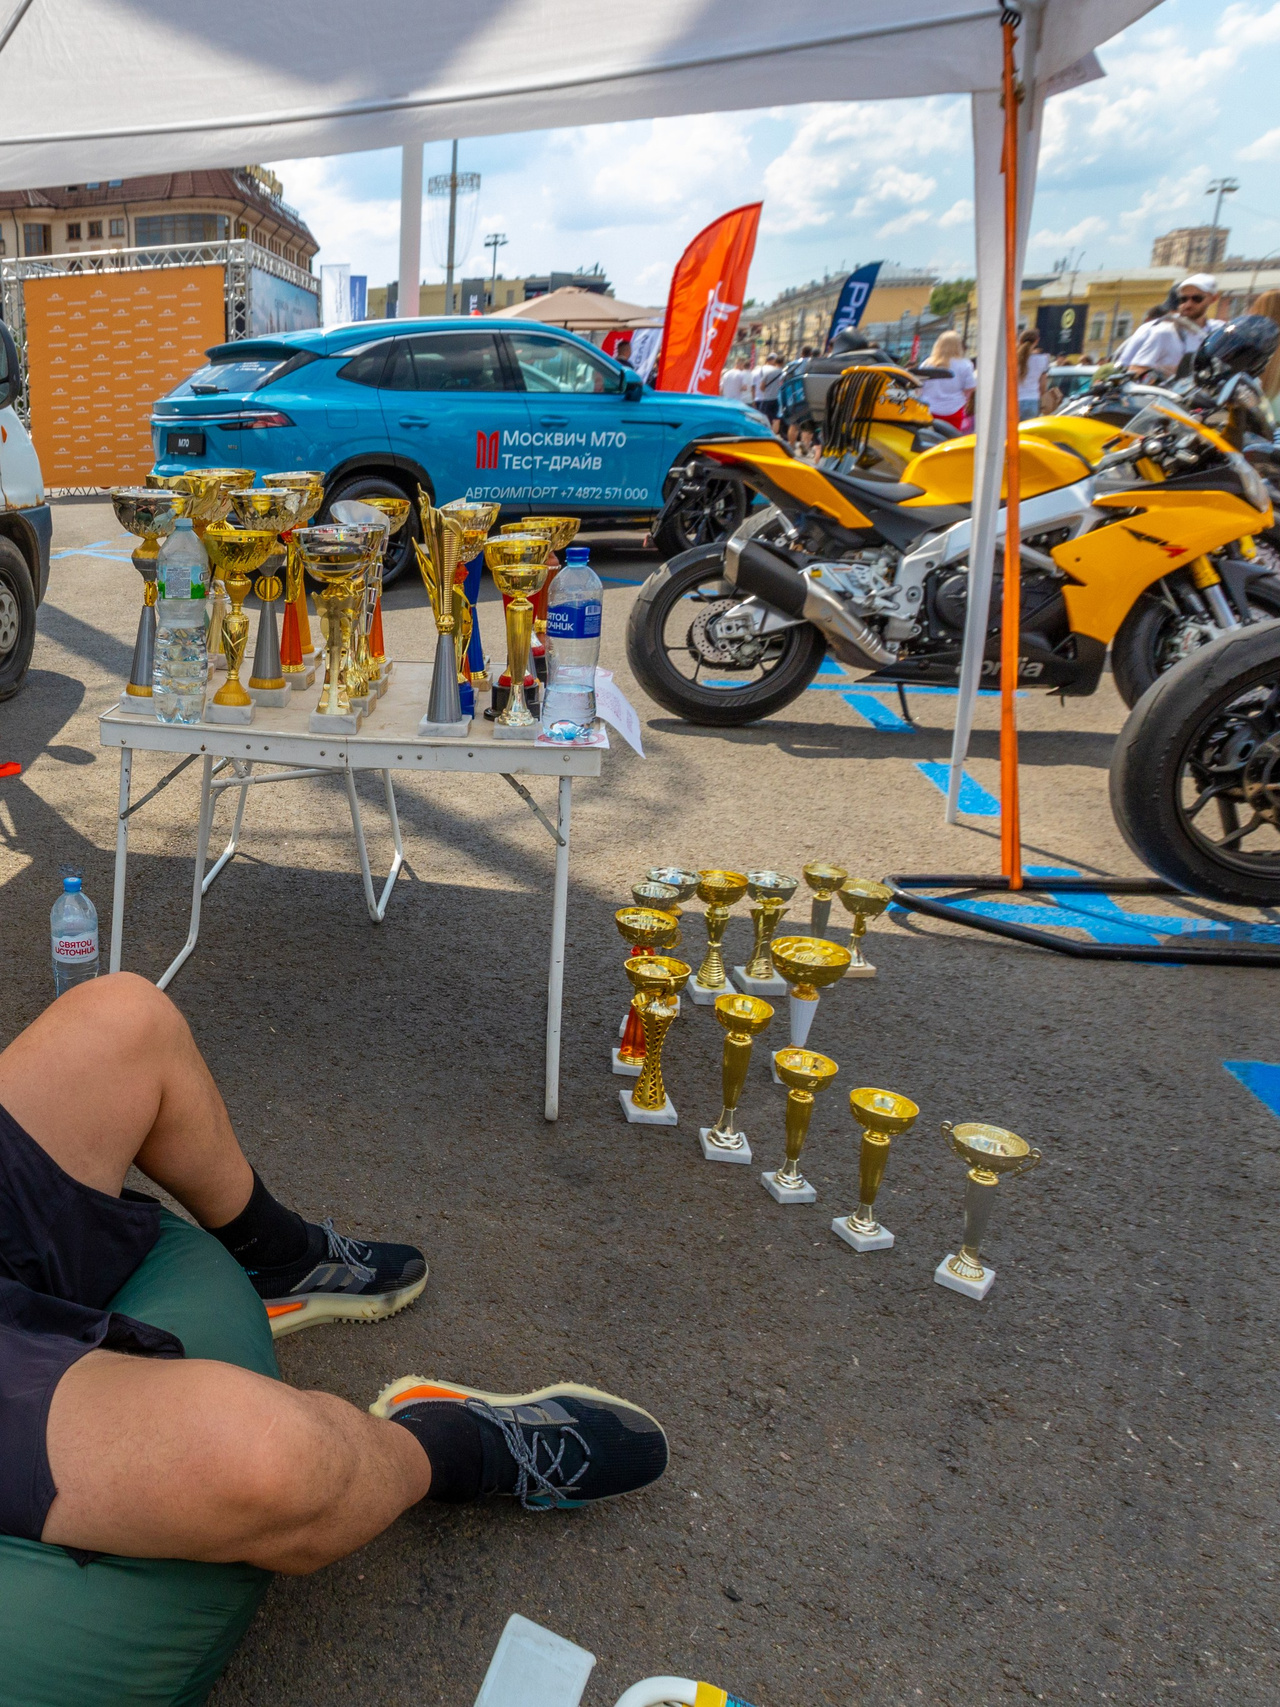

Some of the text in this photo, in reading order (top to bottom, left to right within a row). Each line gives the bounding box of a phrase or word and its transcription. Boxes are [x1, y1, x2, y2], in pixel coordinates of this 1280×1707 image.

[465, 486, 648, 500] АВТОИМПОРТ +7 4872 571 000
[59, 939, 92, 949] СВЯТОЙ
[55, 946, 95, 956] ИСТОЧНИК
